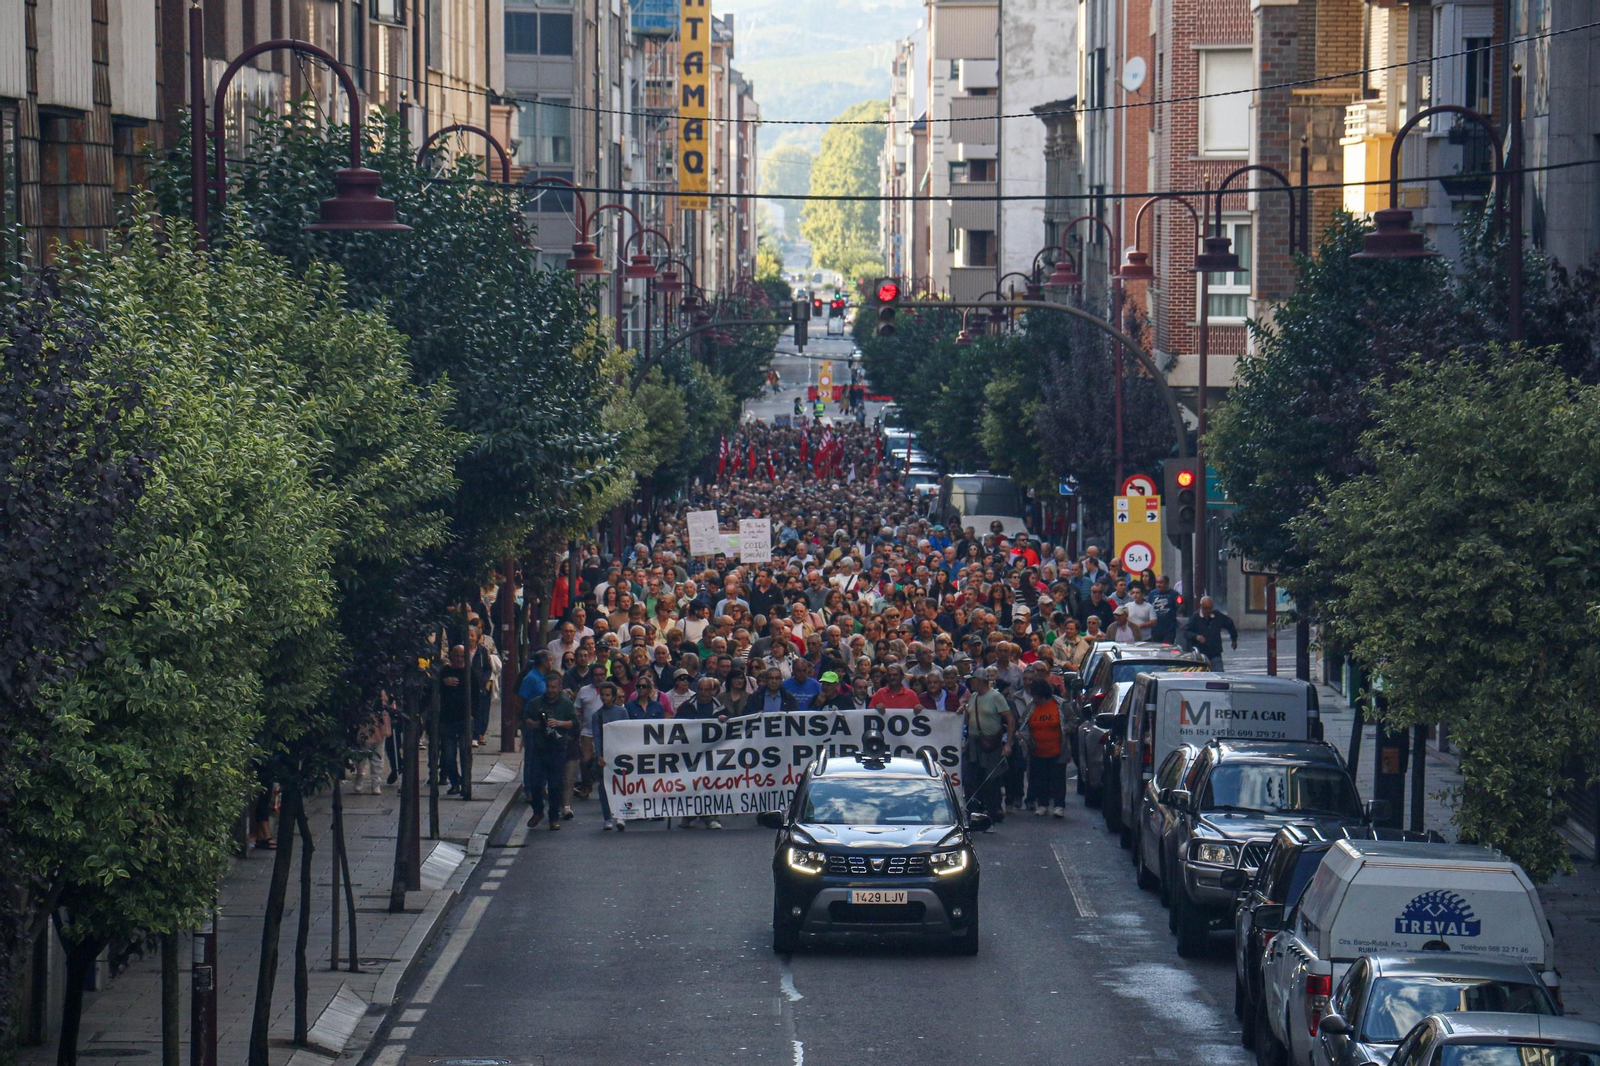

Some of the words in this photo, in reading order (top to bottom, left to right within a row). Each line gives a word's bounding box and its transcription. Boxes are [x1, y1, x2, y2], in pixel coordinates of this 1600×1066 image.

[682, 0, 706, 174] TAMAQ
[1129, 553, 1142, 563] 5,5
[1145, 553, 1149, 562] t
[1215, 709, 1249, 720] RENT
[1251, 710, 1259, 720] A
[1261, 711, 1286, 721] CAR
[644, 723, 690, 745] NA
[702, 715, 852, 744] DEFENSA
[864, 715, 932, 737] DOS
[1238, 729, 1253, 737] 699
[1255, 730, 1269, 738] 379
[614, 746, 781, 776] SERVIZOS
[612, 768, 646, 796] Non
[653, 778, 686, 793] aos
[693, 764, 776, 791] recortes
[643, 794, 735, 818] PLATAFORMA
[855, 892, 881, 903] 1429
[884, 892, 905, 903] LJV
[1409, 896, 1461, 915] TALLERES
[1400, 919, 1470, 936] TREVAL
